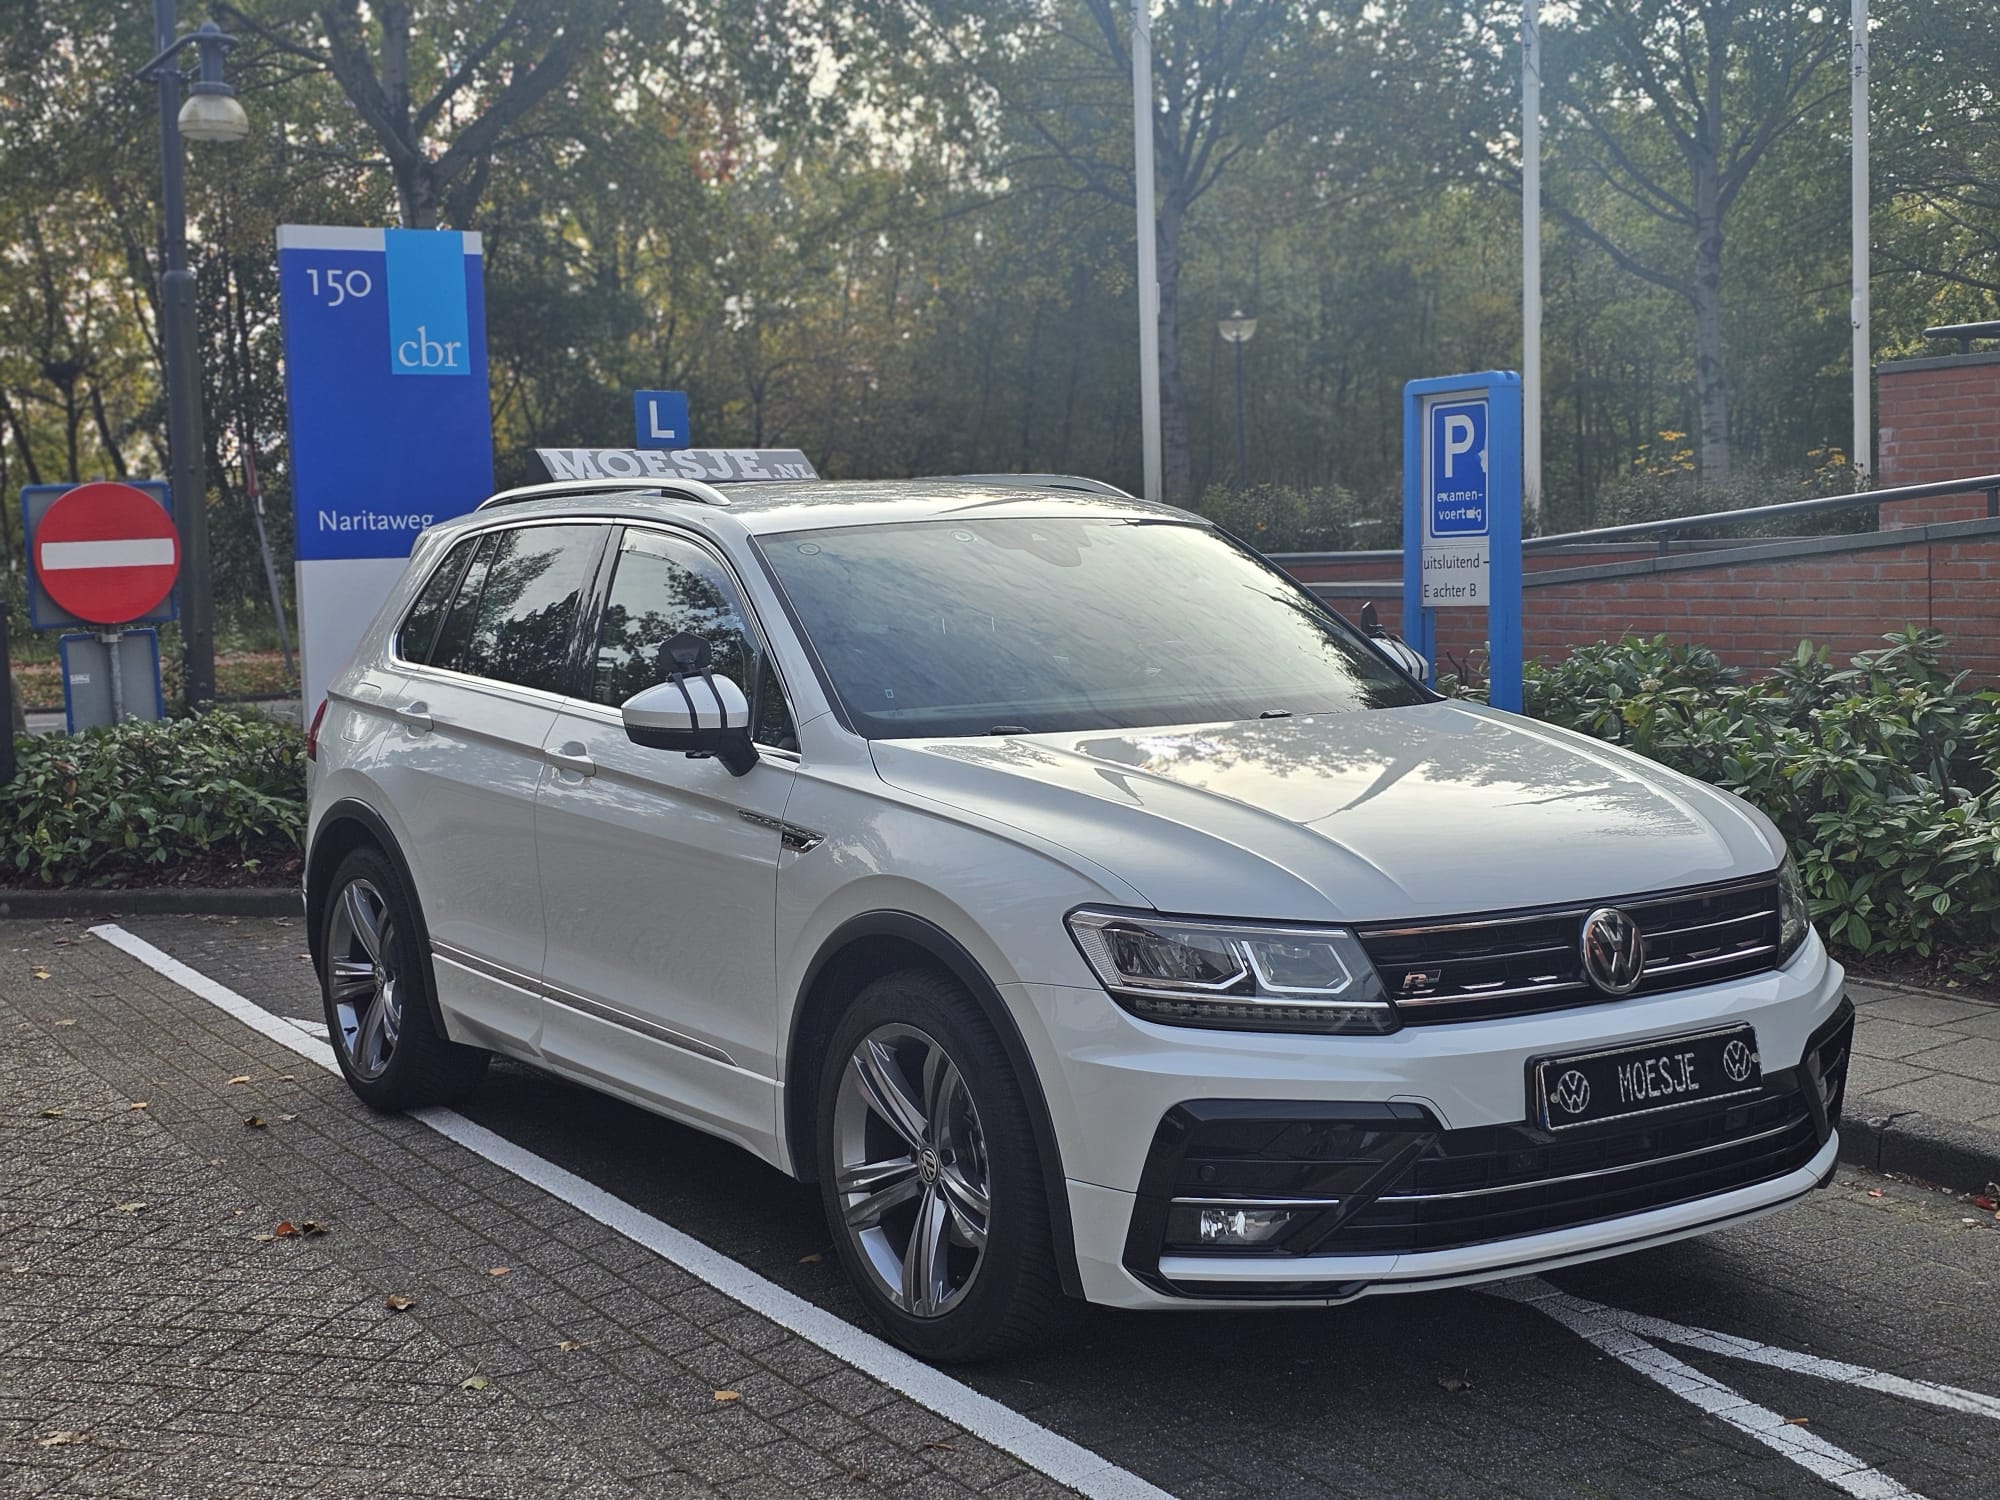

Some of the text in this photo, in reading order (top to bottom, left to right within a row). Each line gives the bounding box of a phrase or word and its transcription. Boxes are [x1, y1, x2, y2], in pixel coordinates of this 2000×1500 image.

[306, 269, 372, 307] 150
[398, 325, 462, 367] cbr
[649, 400, 675, 439] L
[1444, 414, 1475, 478] P
[318, 509, 434, 532] Naritaweg
[1423, 552, 1480, 570] uitsluitend
[1423, 582, 1477, 598] E achter B
[1617, 1052, 1700, 1103] MOESJE
